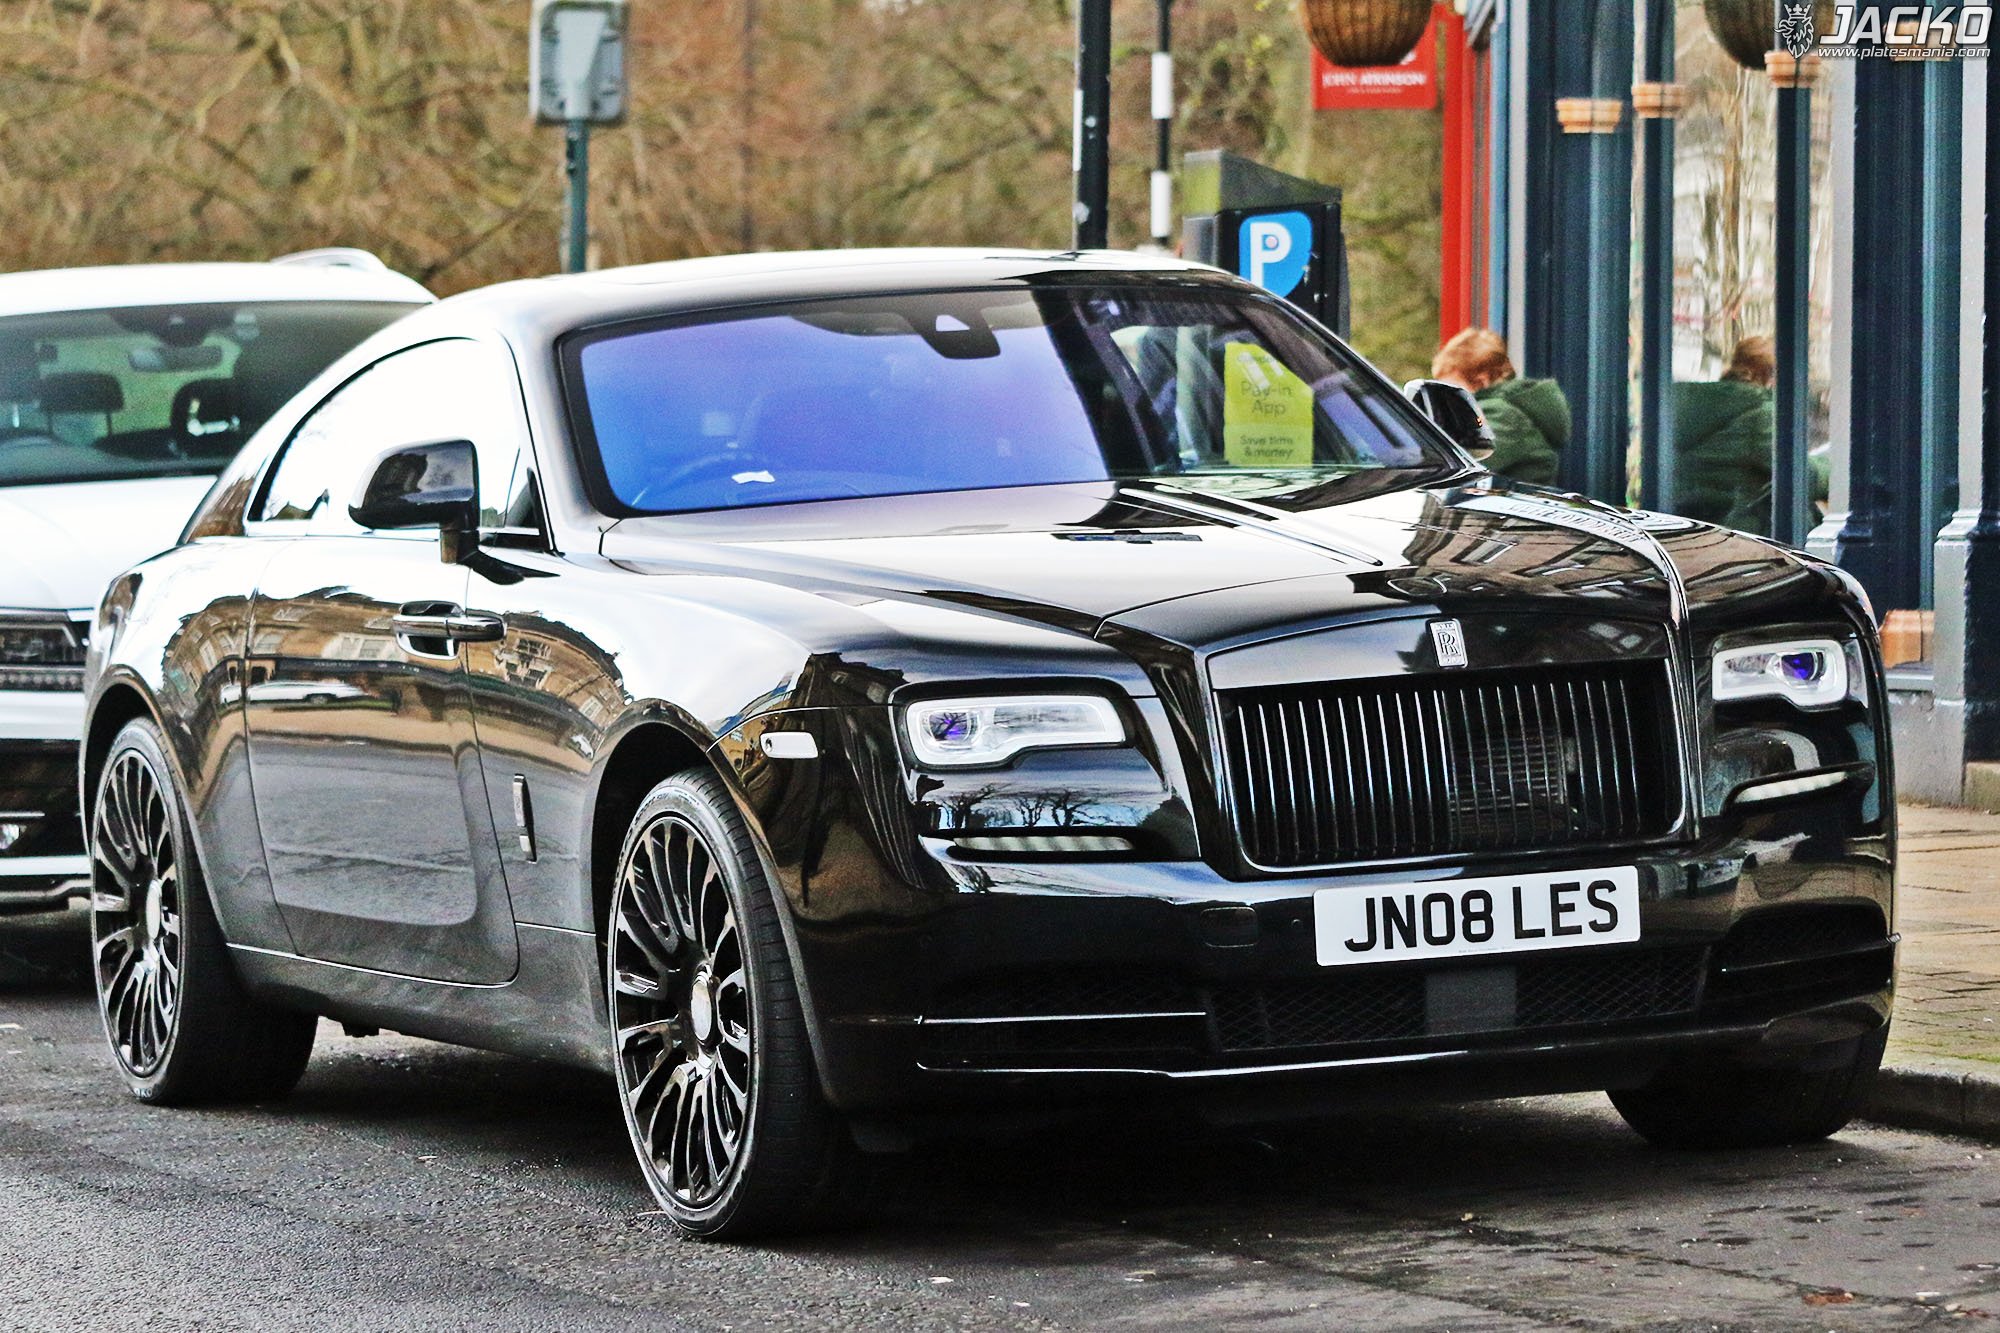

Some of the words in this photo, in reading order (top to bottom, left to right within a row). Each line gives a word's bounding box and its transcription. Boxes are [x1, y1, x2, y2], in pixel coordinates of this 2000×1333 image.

[1322, 73, 1357, 87] JOHN
[1359, 72, 1427, 86] ATKINSON
[1250, 222, 1292, 287] P
[1252, 400, 1287, 417] App
[1254, 448, 1294, 460] money
[1344, 889, 1494, 952] JN08
[1512, 879, 1618, 939] LES
